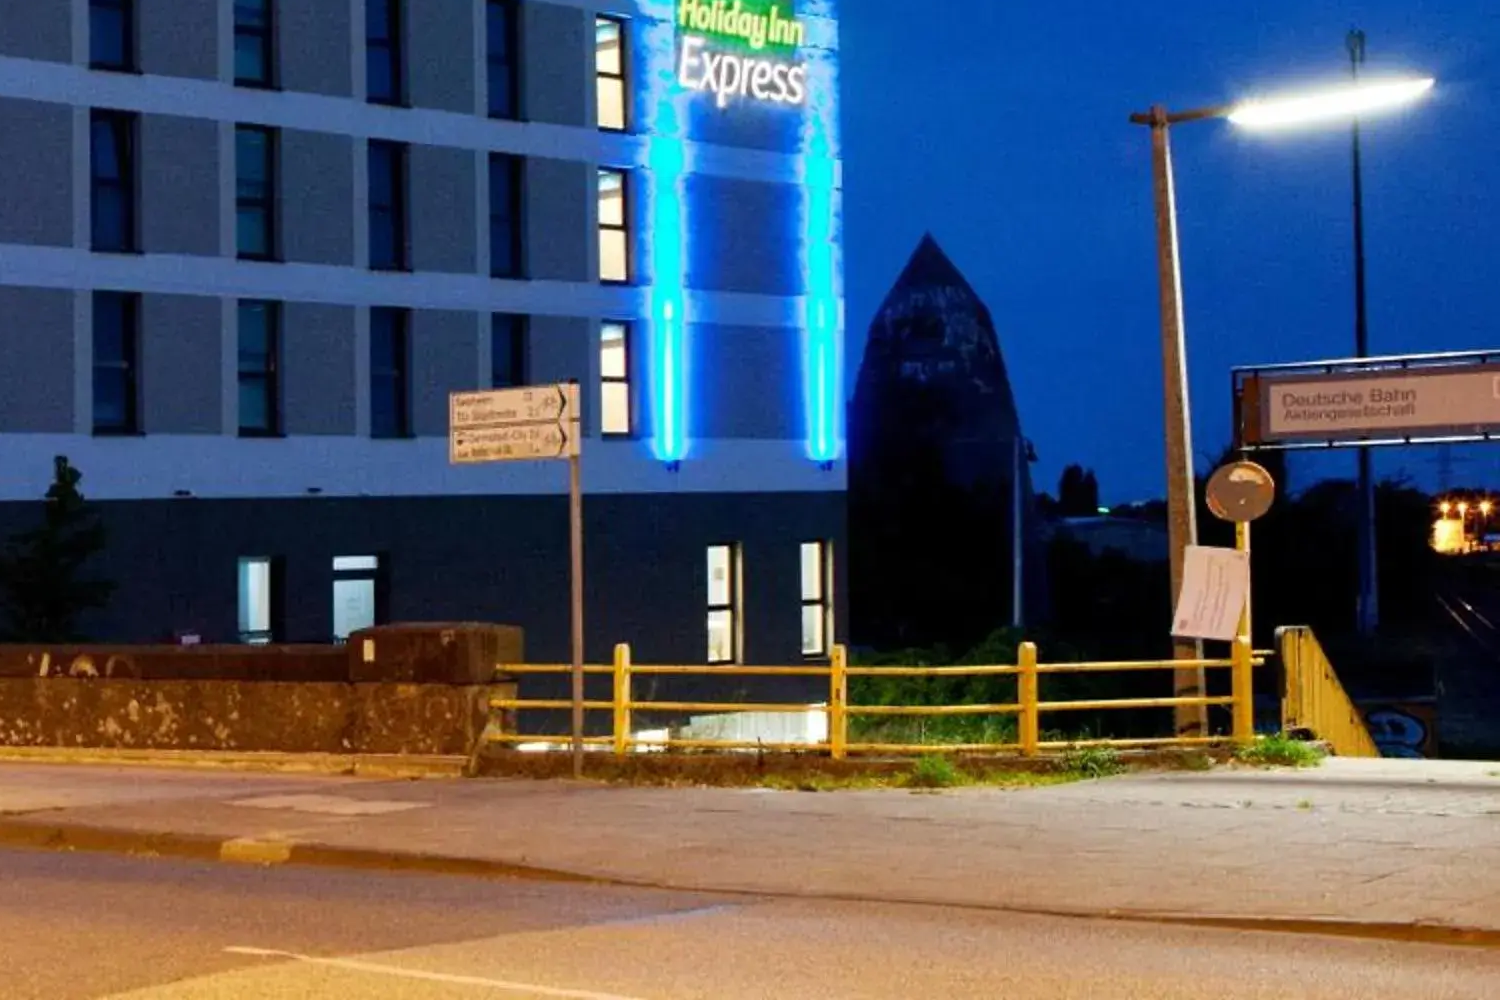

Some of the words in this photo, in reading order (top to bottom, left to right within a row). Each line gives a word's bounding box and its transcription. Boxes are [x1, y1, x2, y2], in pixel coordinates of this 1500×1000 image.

[768, 6, 804, 46] Inn
[678, 35, 807, 108] Express
[1282, 390, 1363, 408] Deutsche
[1368, 387, 1417, 403] Bahn
